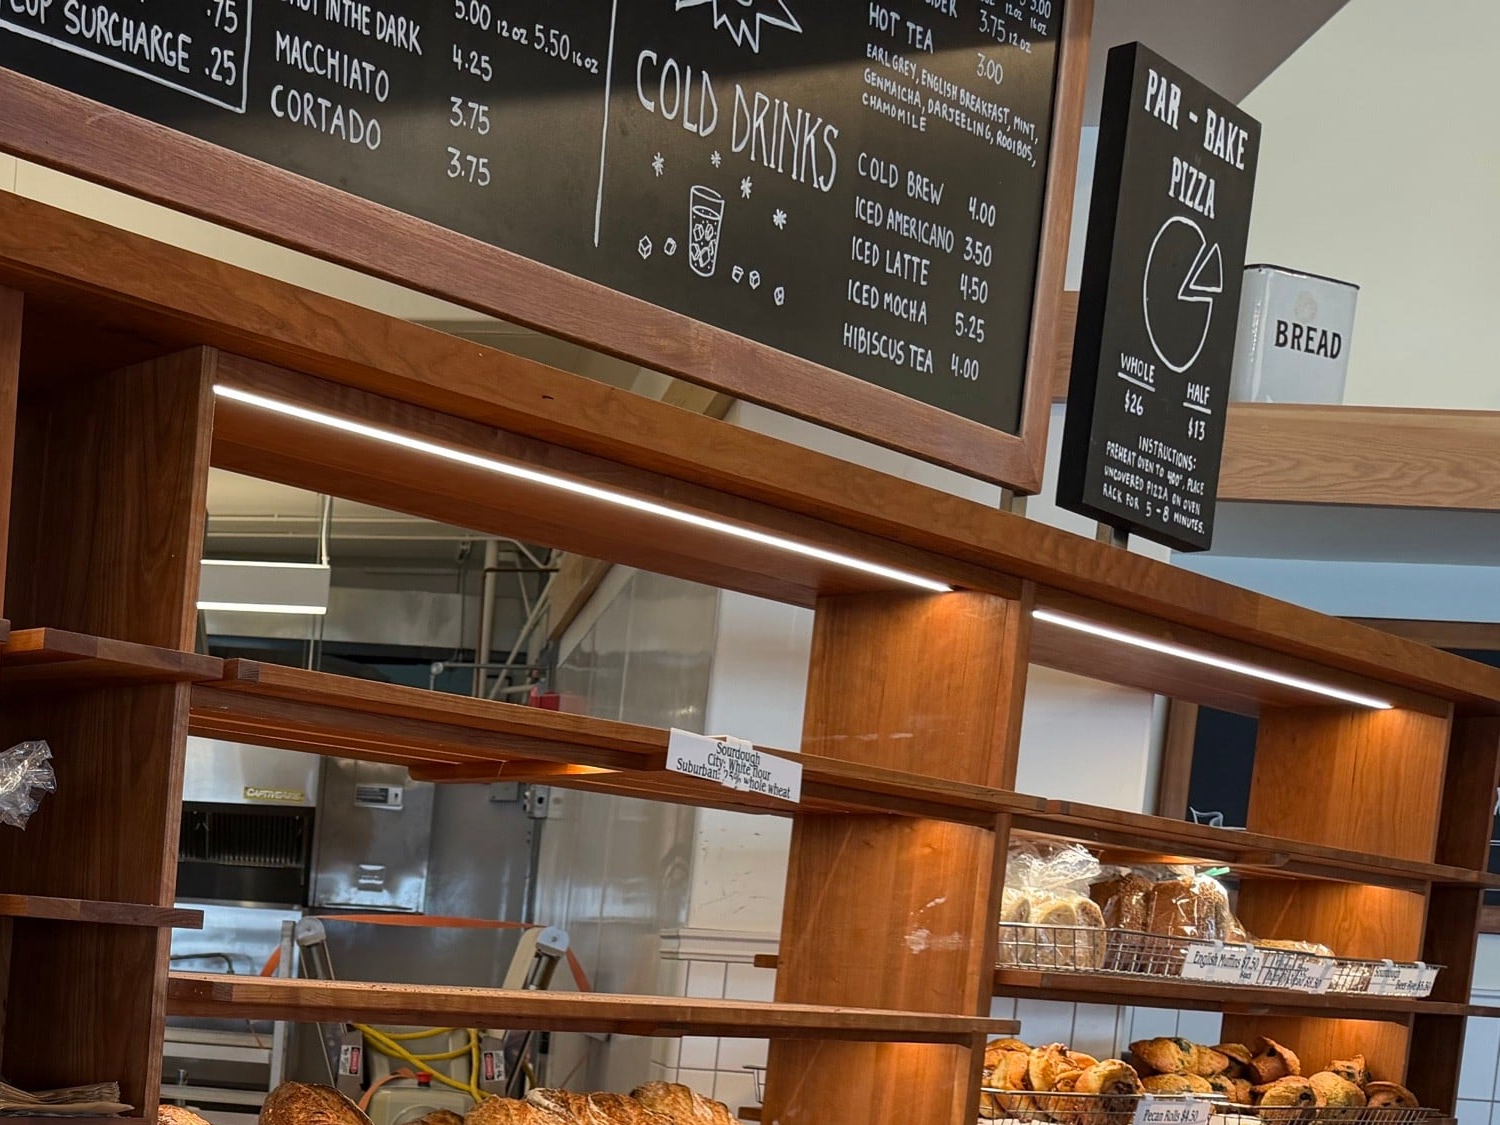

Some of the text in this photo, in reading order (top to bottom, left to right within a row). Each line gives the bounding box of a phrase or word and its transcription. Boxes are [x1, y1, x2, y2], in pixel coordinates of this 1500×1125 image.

[64, 0, 236, 85] SURCHARGE .25
[376, 11, 493, 82] DARK 4.25
[534, 24, 570, 60] 5.50
[869, 2, 900, 37] HOT
[906, 21, 934, 54] TEA
[976, 53, 1003, 85] 3.00
[979, 10, 1006, 42] 3.75
[276, 30, 490, 135] MACCHIATO 3.75
[866, 43, 891, 68] EARL
[892, 55, 919, 84] GREY,
[921, 69, 957, 101] ENGLISH
[271, 85, 490, 186] CORTADO 3.75
[637, 50, 839, 192] COLD DRINKS
[862, 93, 927, 132] CHAMOMILE
[1144, 68, 1248, 171] PAR BAKE
[858, 152, 996, 227] COLD BREW 4.00
[1168, 156, 1215, 220] PIZZA
[855, 196, 992, 267] ICED AMERICANO 3.50
[851, 236, 988, 304] ICED LATTE 4.50
[848, 279, 985, 343] ICED MOCHA 5.25
[843, 322, 979, 381] HIBISCUS TEA 4.00
[1274, 319, 1343, 360] BREAD
[1120, 353, 1156, 384] WHOLE
[1187, 382, 1210, 405] HALF
[1124, 389, 1144, 416] $26
[1188, 417, 1205, 441] $13
[1106, 441, 1204, 496] PREHEAT OVEN TO PLACE
[1138, 436, 1197, 471] INSTRUCTIONS:
[1102, 482, 1122, 504] RACK
[1125, 493, 1139, 510] FOR
[1104, 465, 1200, 516] UNCOVERED PIZZA ON OVEN
[676, 758, 720, 779] Suburban:
[744, 776, 767, 792] whole
[768, 783, 790, 799] wheat
[707, 753, 771, 781] City: White flour
[716, 742, 761, 767] Sourdough
[1142, 1110, 1163, 1122] Pecan
